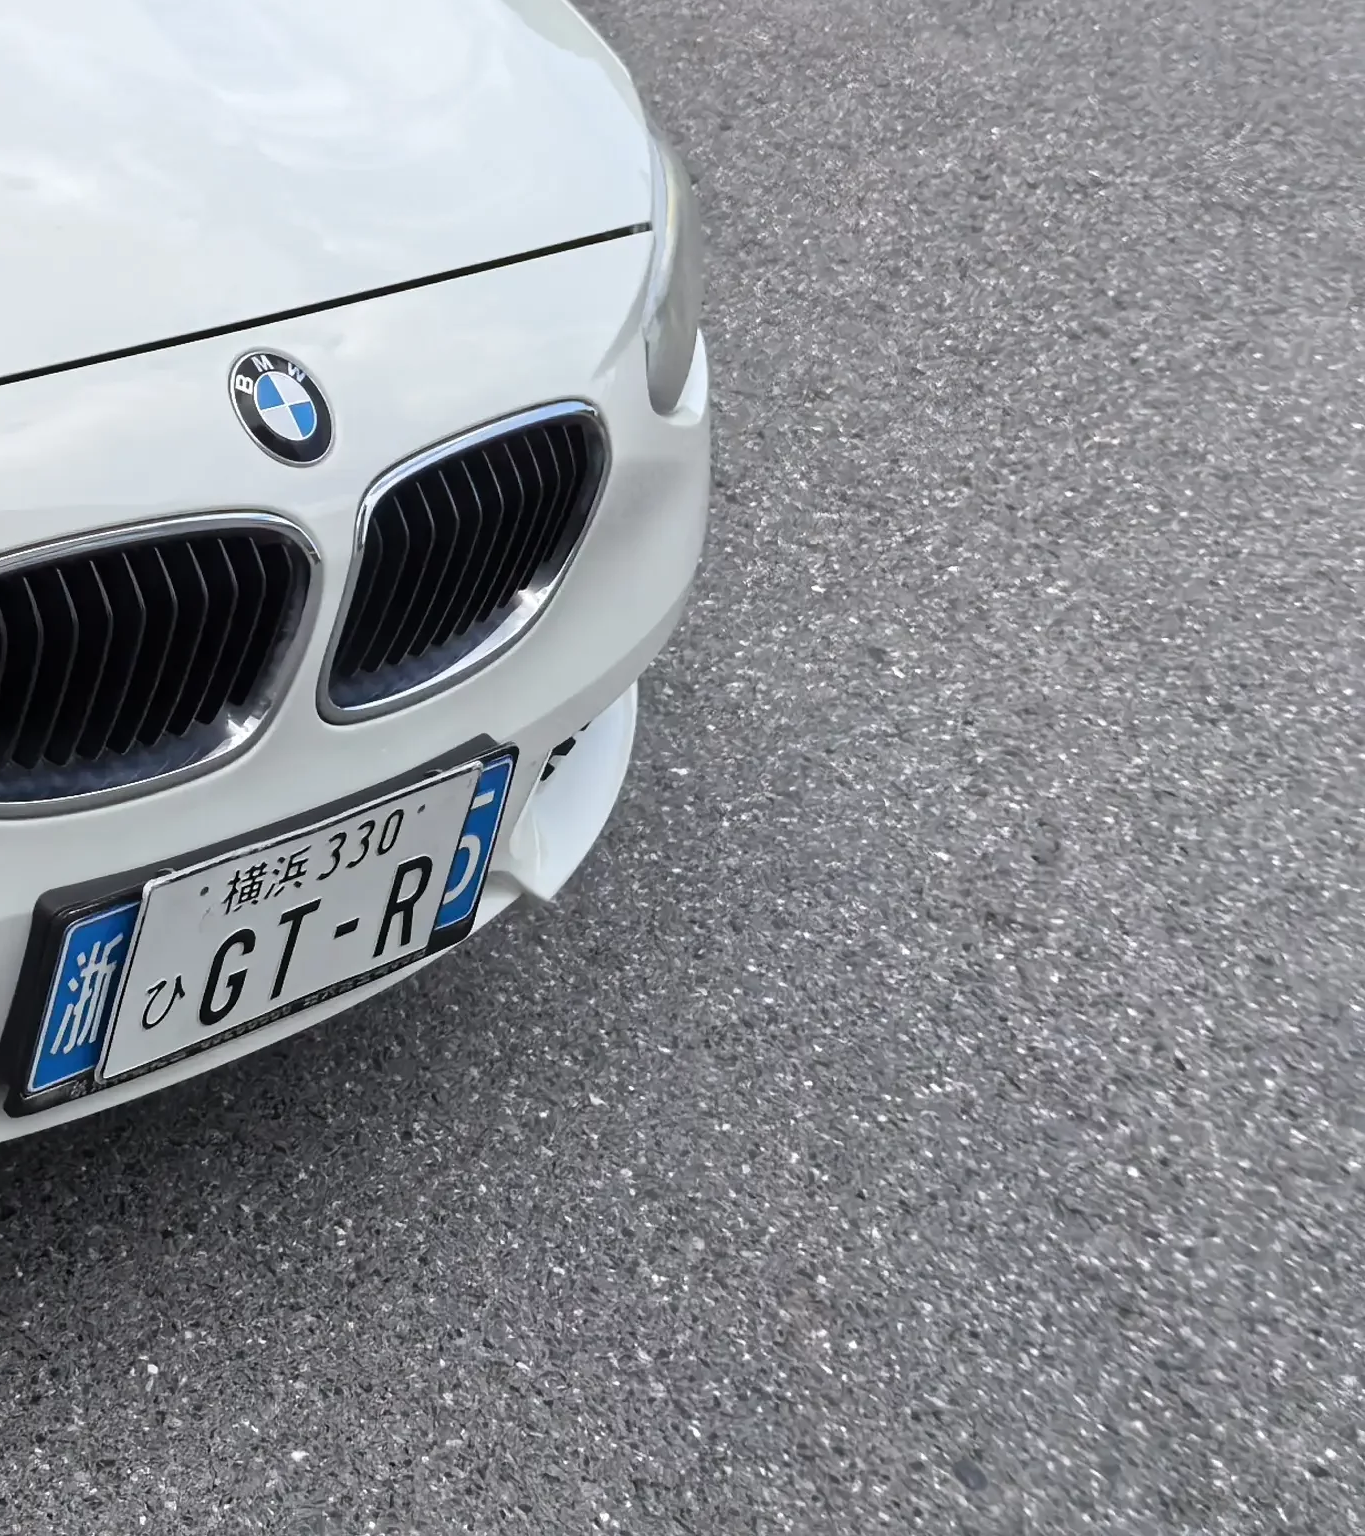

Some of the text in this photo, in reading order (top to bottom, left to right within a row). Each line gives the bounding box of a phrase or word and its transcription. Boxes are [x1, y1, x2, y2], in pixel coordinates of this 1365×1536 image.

[235, 354, 306, 394] BMW
[221, 809, 404, 915] 横浜 330
[49, 933, 124, 1055] 浙
[142, 975, 186, 1030] ひ
[198, 855, 434, 1026] GT-R
